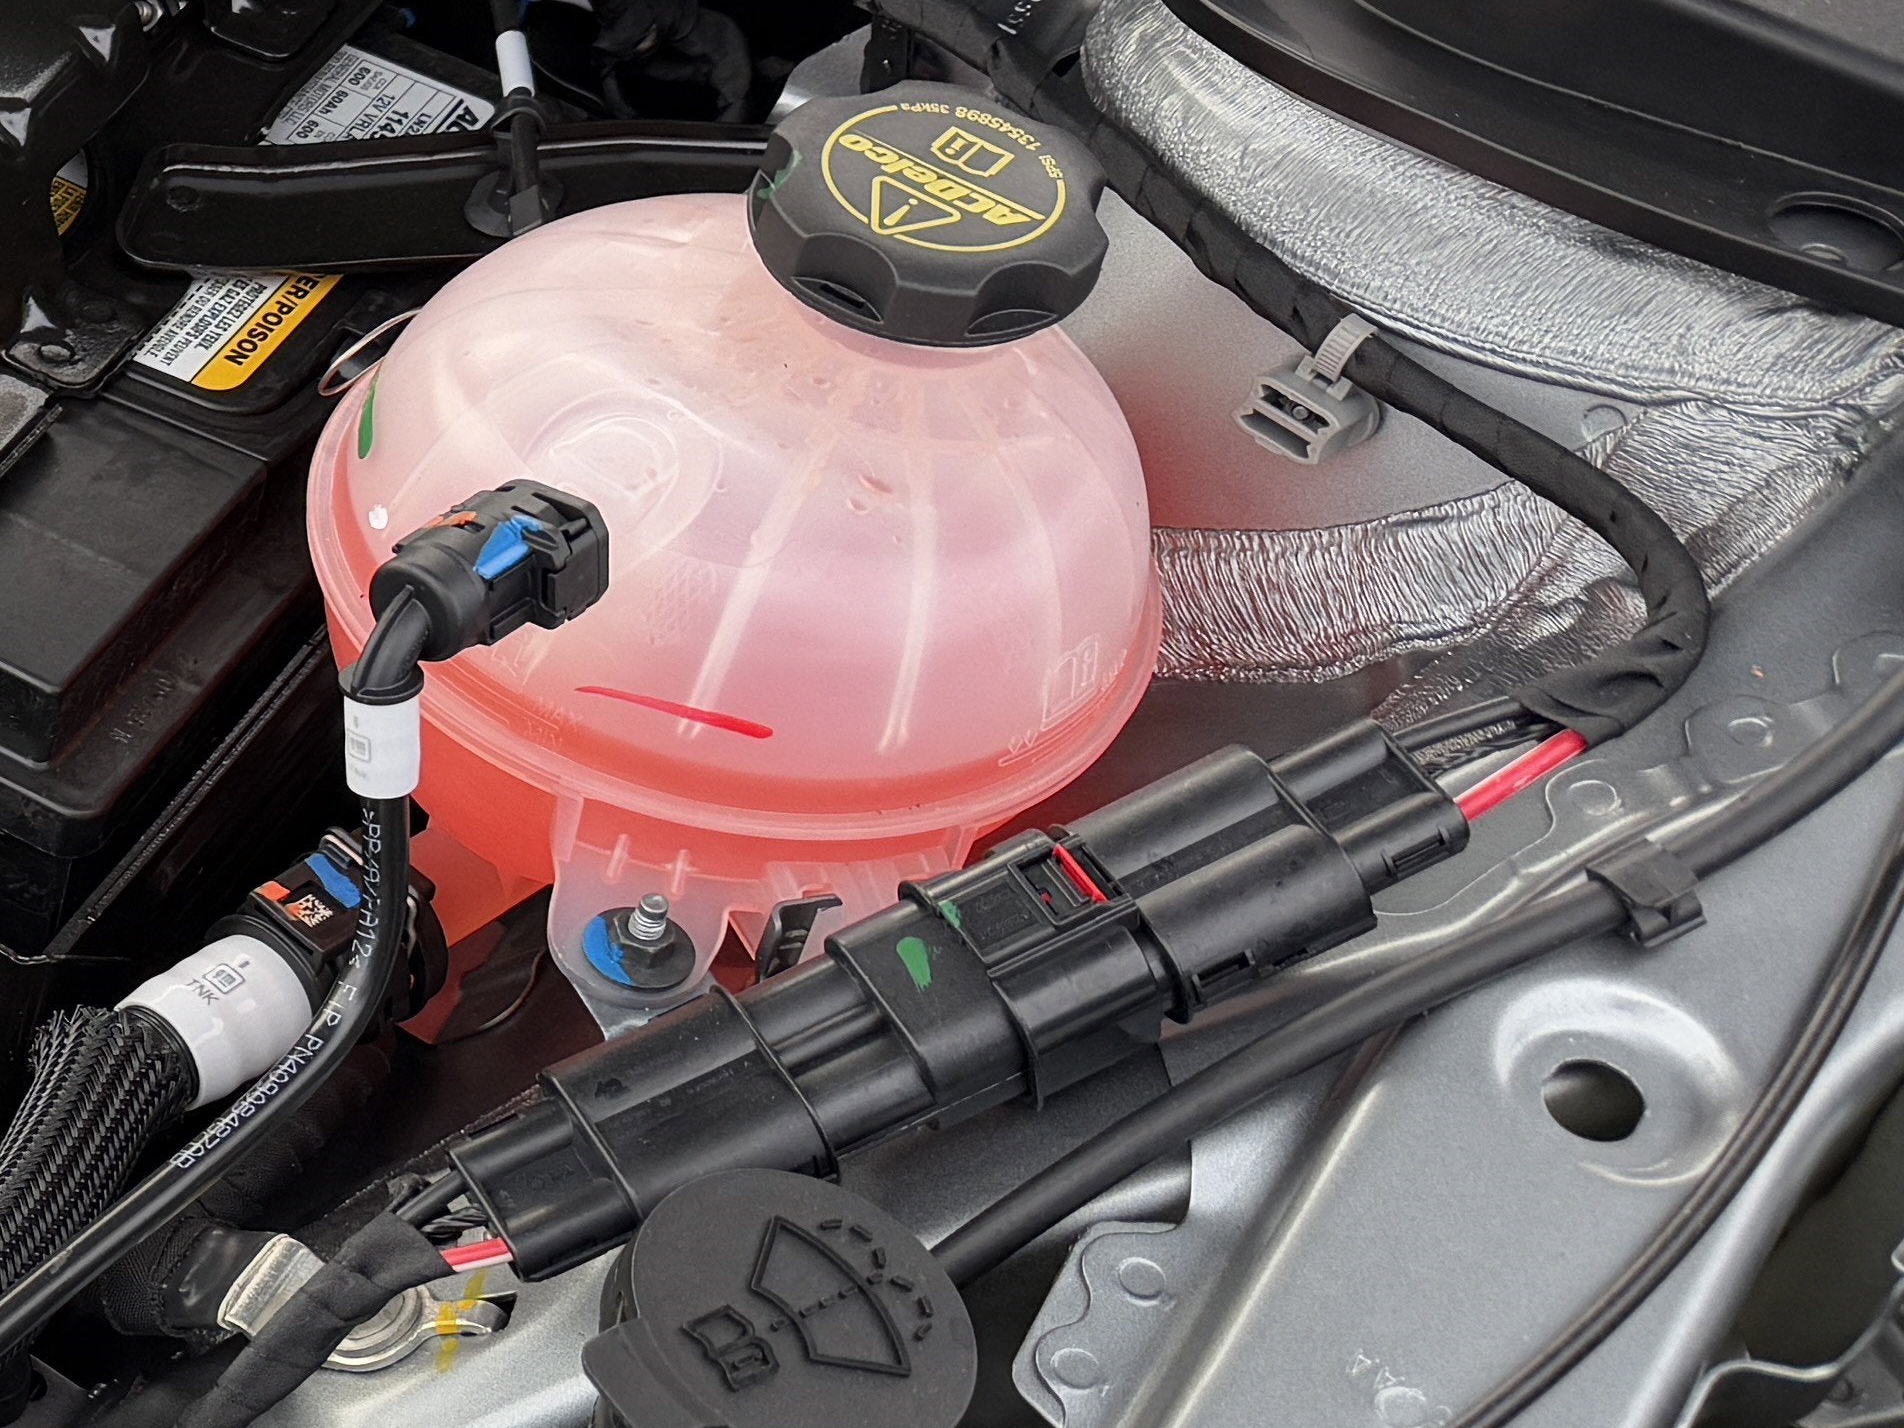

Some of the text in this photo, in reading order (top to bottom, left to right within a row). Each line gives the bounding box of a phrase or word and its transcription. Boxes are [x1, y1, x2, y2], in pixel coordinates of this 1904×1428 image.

[955, 105, 1042, 151] 13545898
[839, 133, 1032, 226] ACDelco
[225, 274, 325, 366] ER/POISON
[188, 977, 221, 1006] TNK
